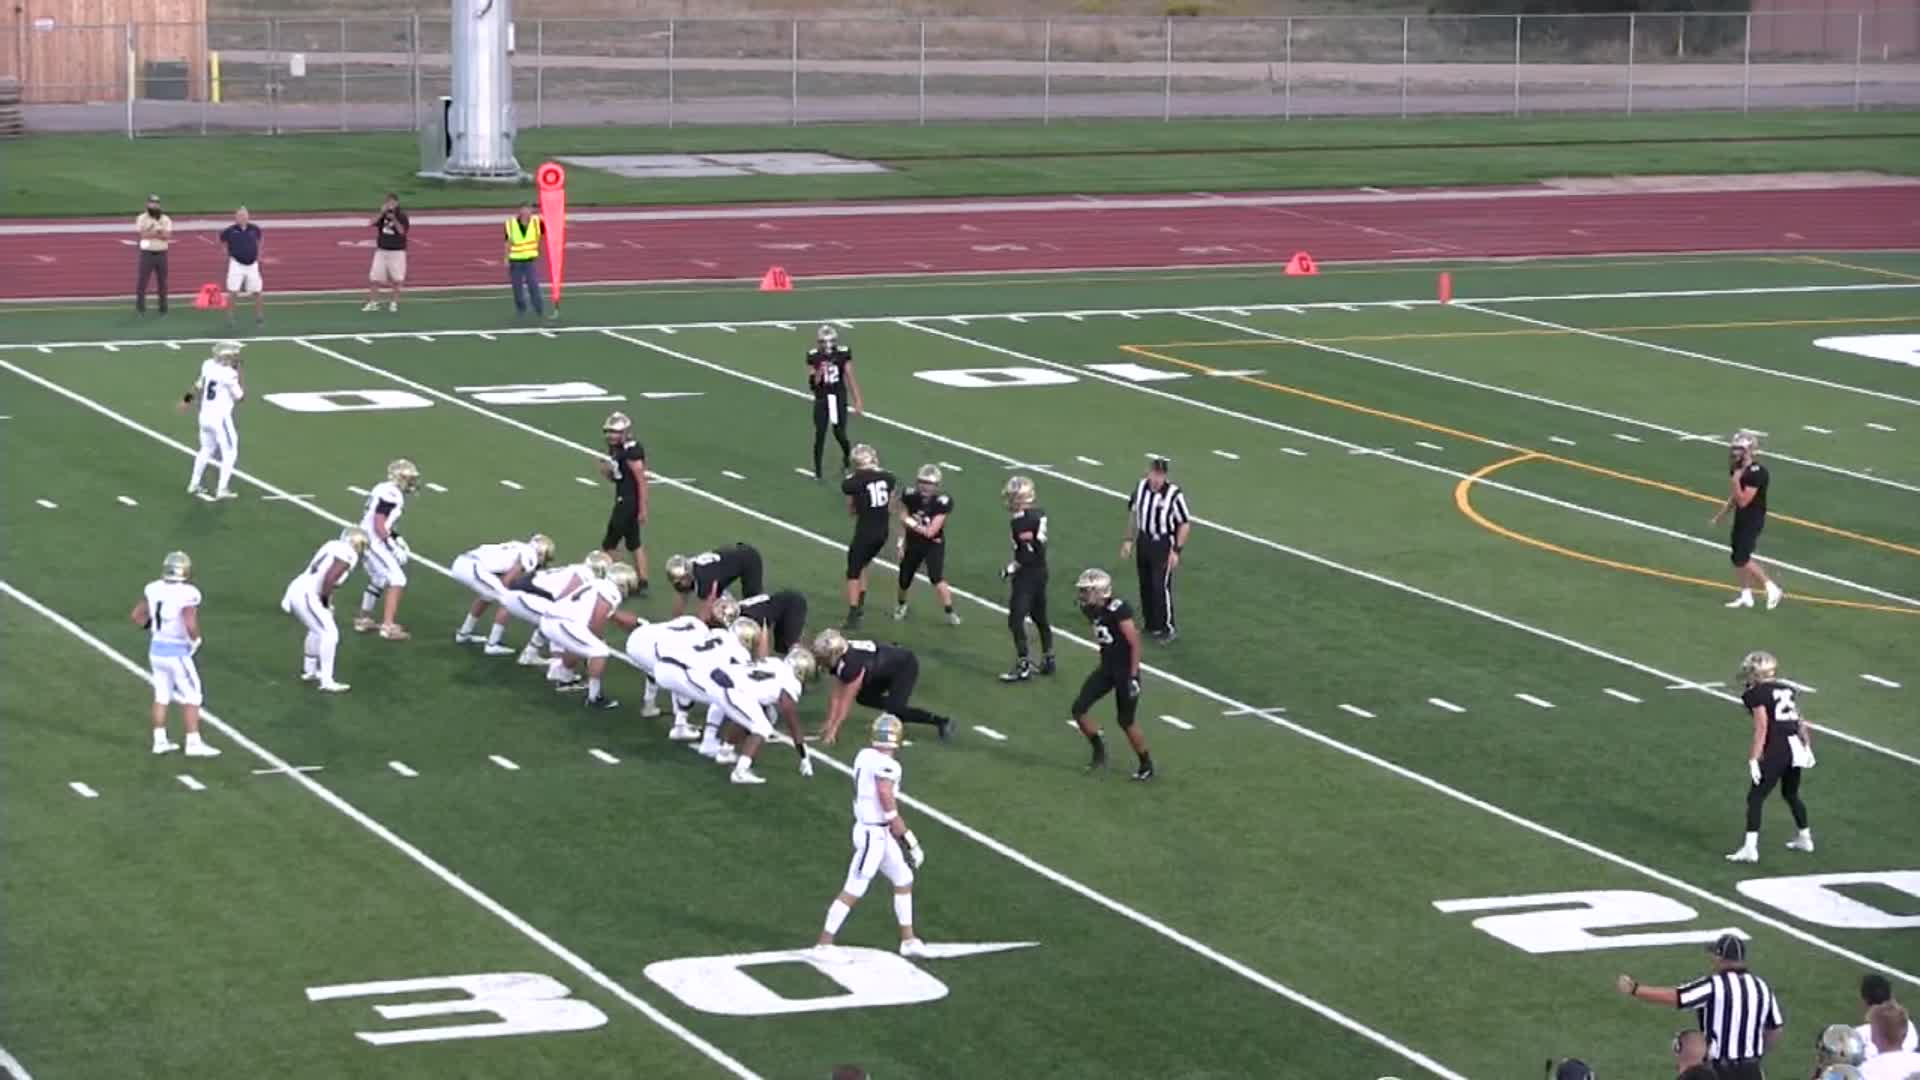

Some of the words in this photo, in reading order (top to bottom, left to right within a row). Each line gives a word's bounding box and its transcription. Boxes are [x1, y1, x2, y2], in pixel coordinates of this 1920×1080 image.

[772, 270, 787, 289] 10
[866, 480, 889, 507] 16
[154, 600, 163, 632] 1
[1433, 871, 1920, 954] 20
[305, 945, 950, 1046] 30
